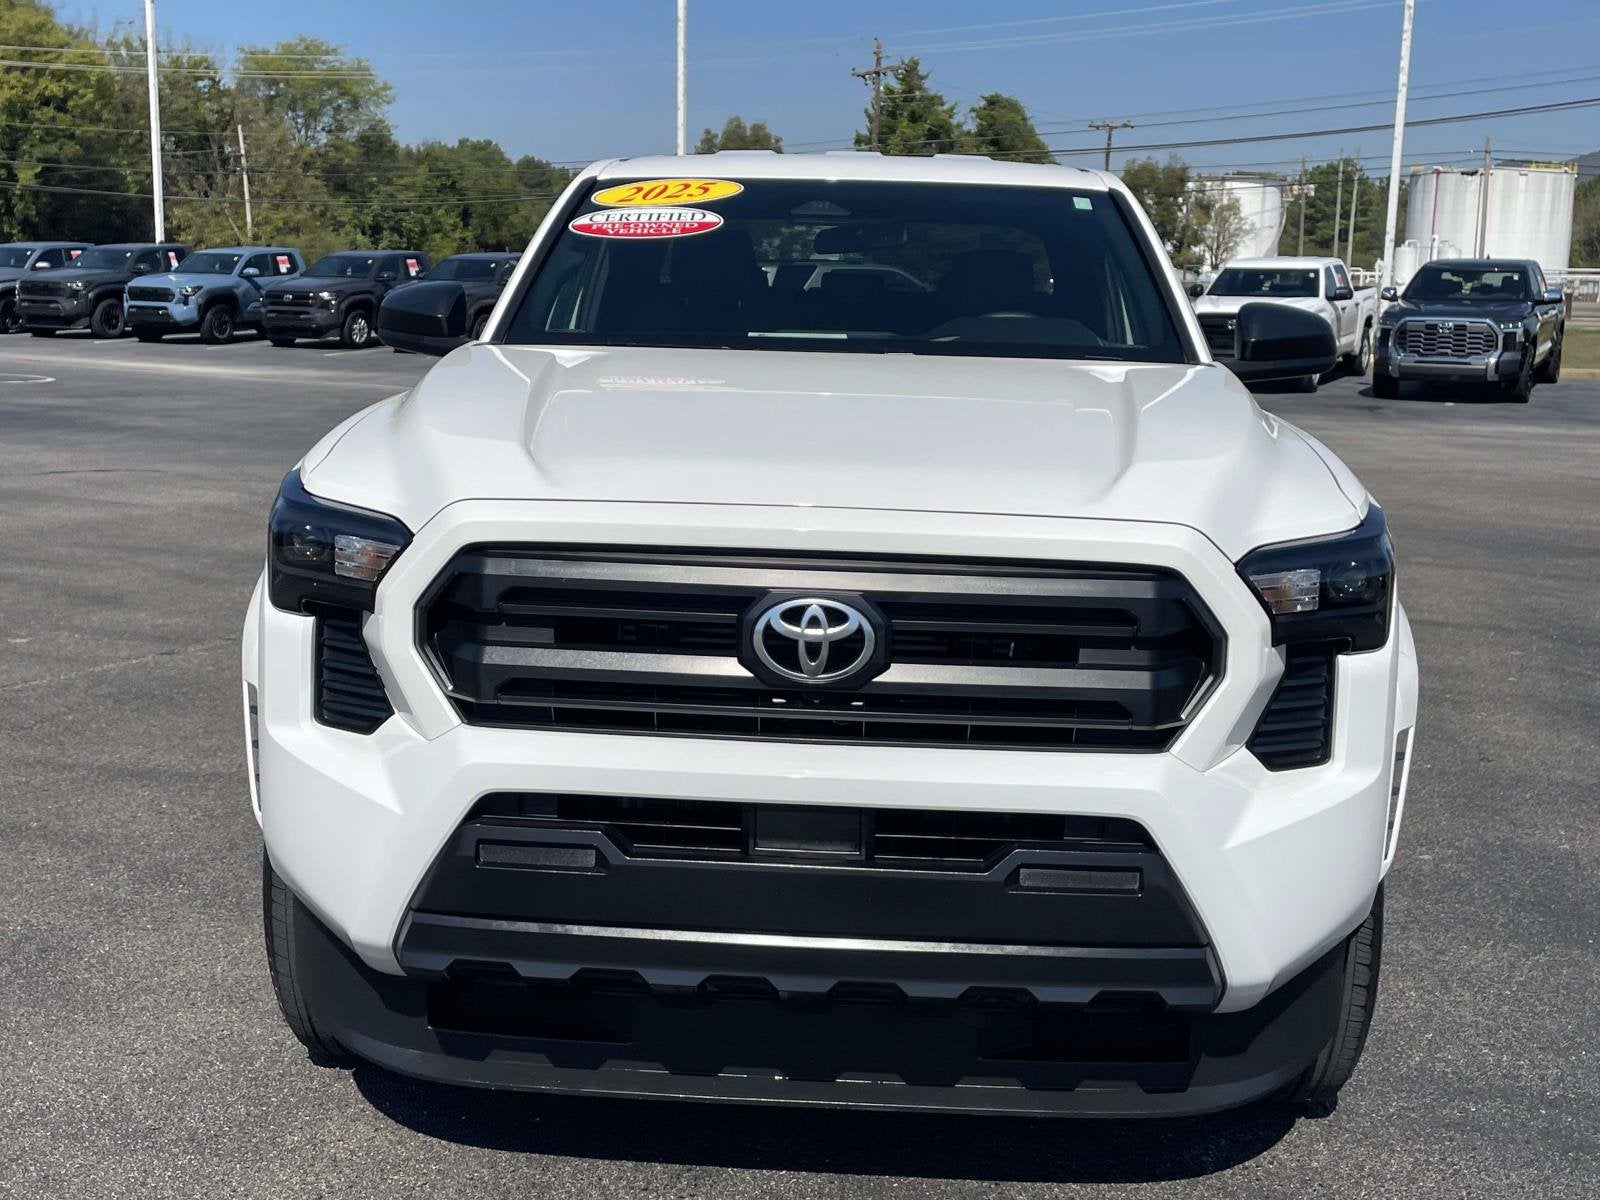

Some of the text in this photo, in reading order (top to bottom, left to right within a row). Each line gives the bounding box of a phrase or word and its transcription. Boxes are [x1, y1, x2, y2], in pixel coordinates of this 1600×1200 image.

[616, 182, 716, 202] 2025
[589, 212, 706, 222] CERTIFIED
[592, 221, 698, 229] PRE-OWNED
